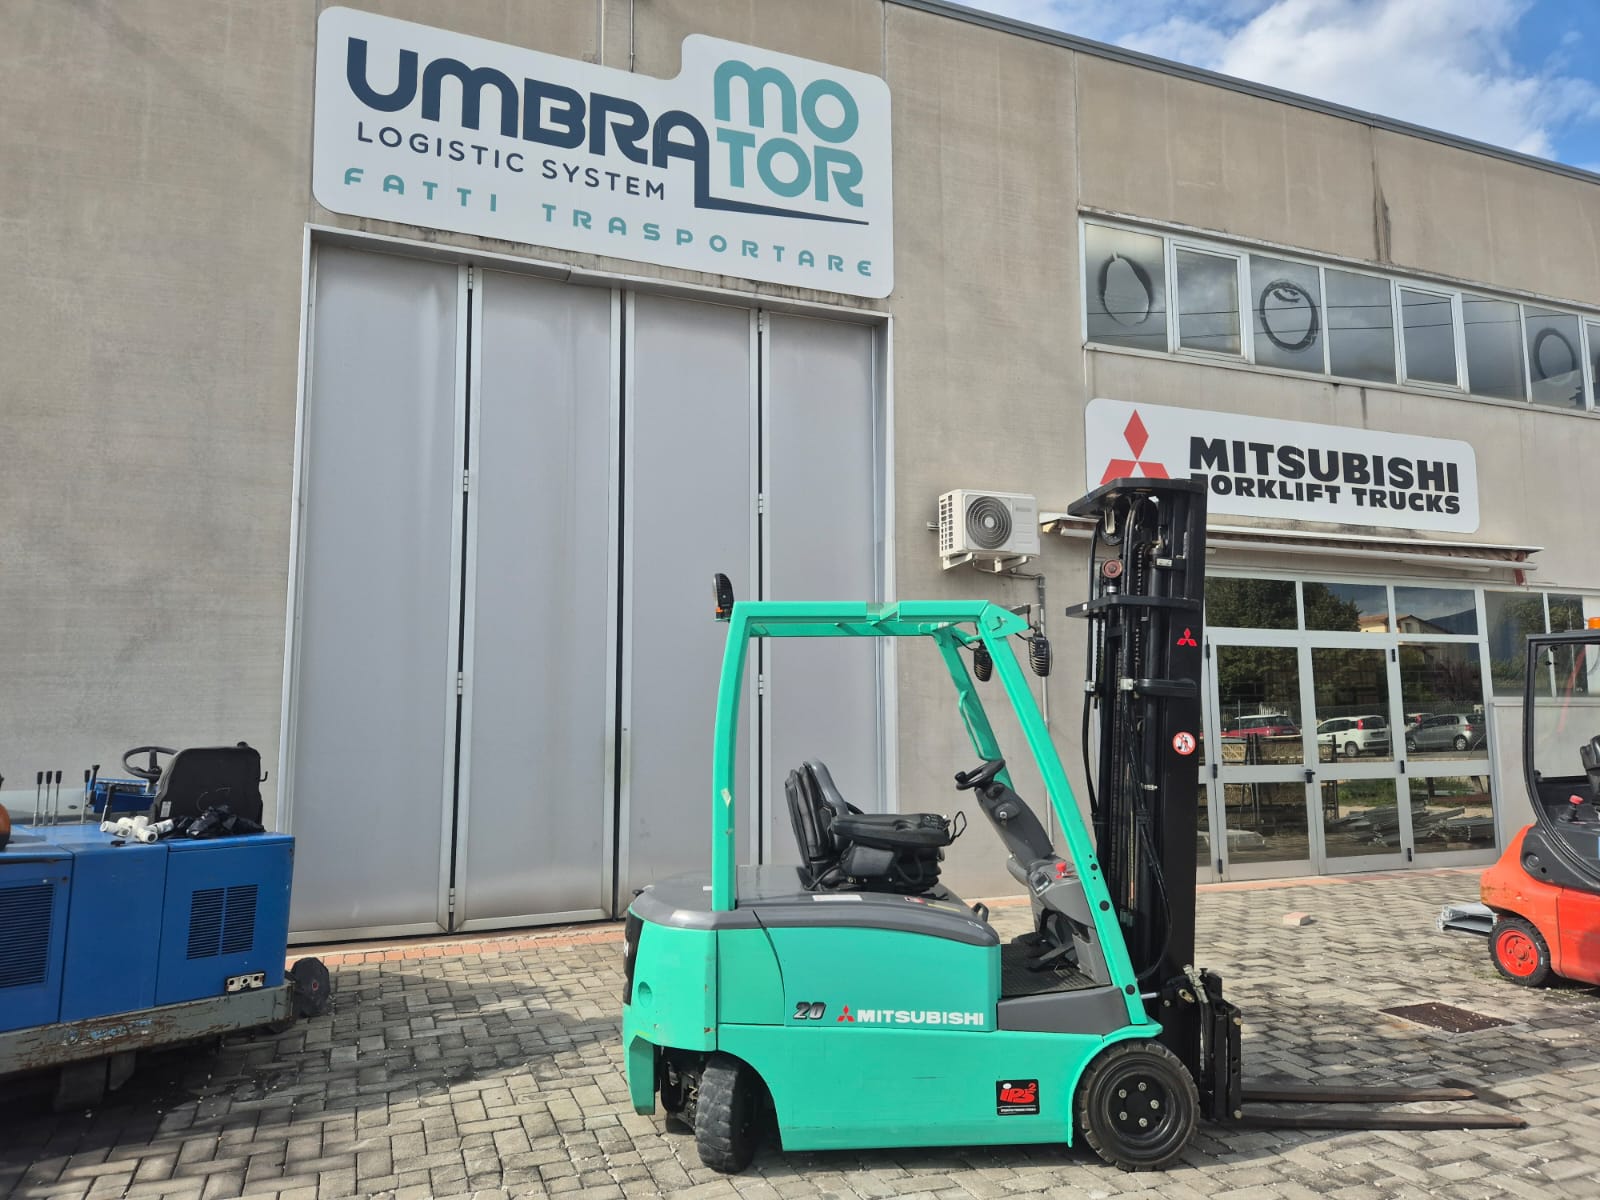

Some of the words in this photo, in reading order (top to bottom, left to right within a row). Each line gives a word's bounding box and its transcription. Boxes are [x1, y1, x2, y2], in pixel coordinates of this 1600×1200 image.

[347, 37, 710, 207] UMBRA
[357, 120, 524, 173] LOGISTIC
[541, 158, 665, 201] SYSTEM
[343, 167, 497, 213] FATTI
[541, 203, 872, 277] TRASPORTARE
[1189, 436, 1459, 494] MITSUBISHI
[1351, 486, 1461, 515] TRUCKS
[793, 1001, 827, 1020] 20
[857, 1009, 984, 1026] MITSUBISHI
